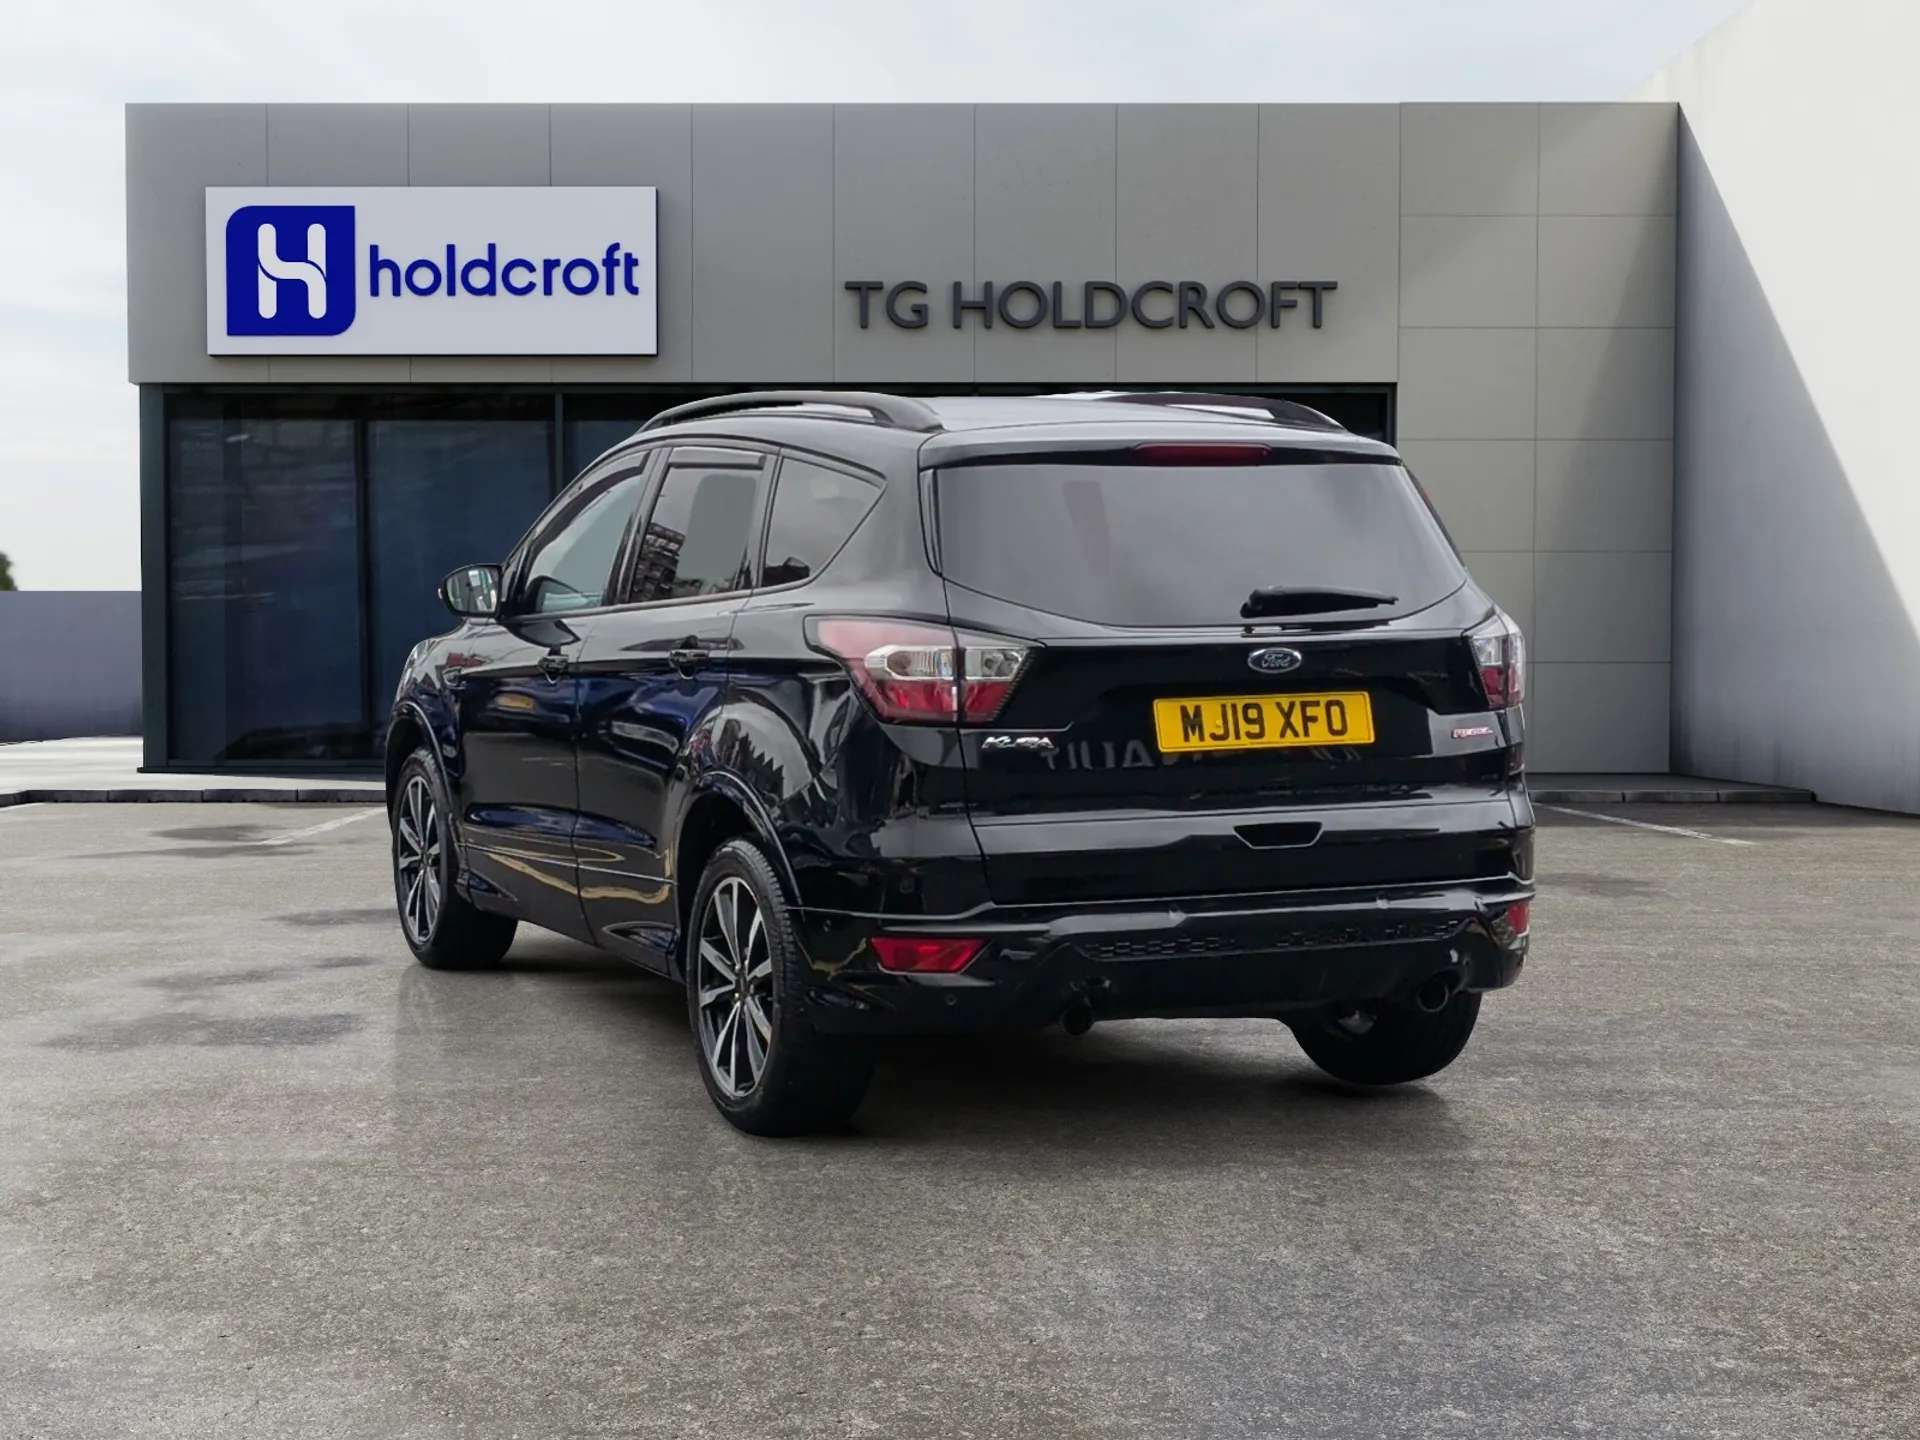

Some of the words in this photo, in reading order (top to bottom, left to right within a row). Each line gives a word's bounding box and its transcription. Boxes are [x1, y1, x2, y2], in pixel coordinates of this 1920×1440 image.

[369, 242, 640, 298] holdcroft
[844, 280, 929, 329] TG
[952, 280, 1338, 329] HOLDCROFT
[1179, 702, 1266, 743] MJ19
[1275, 699, 1348, 739] XFO
